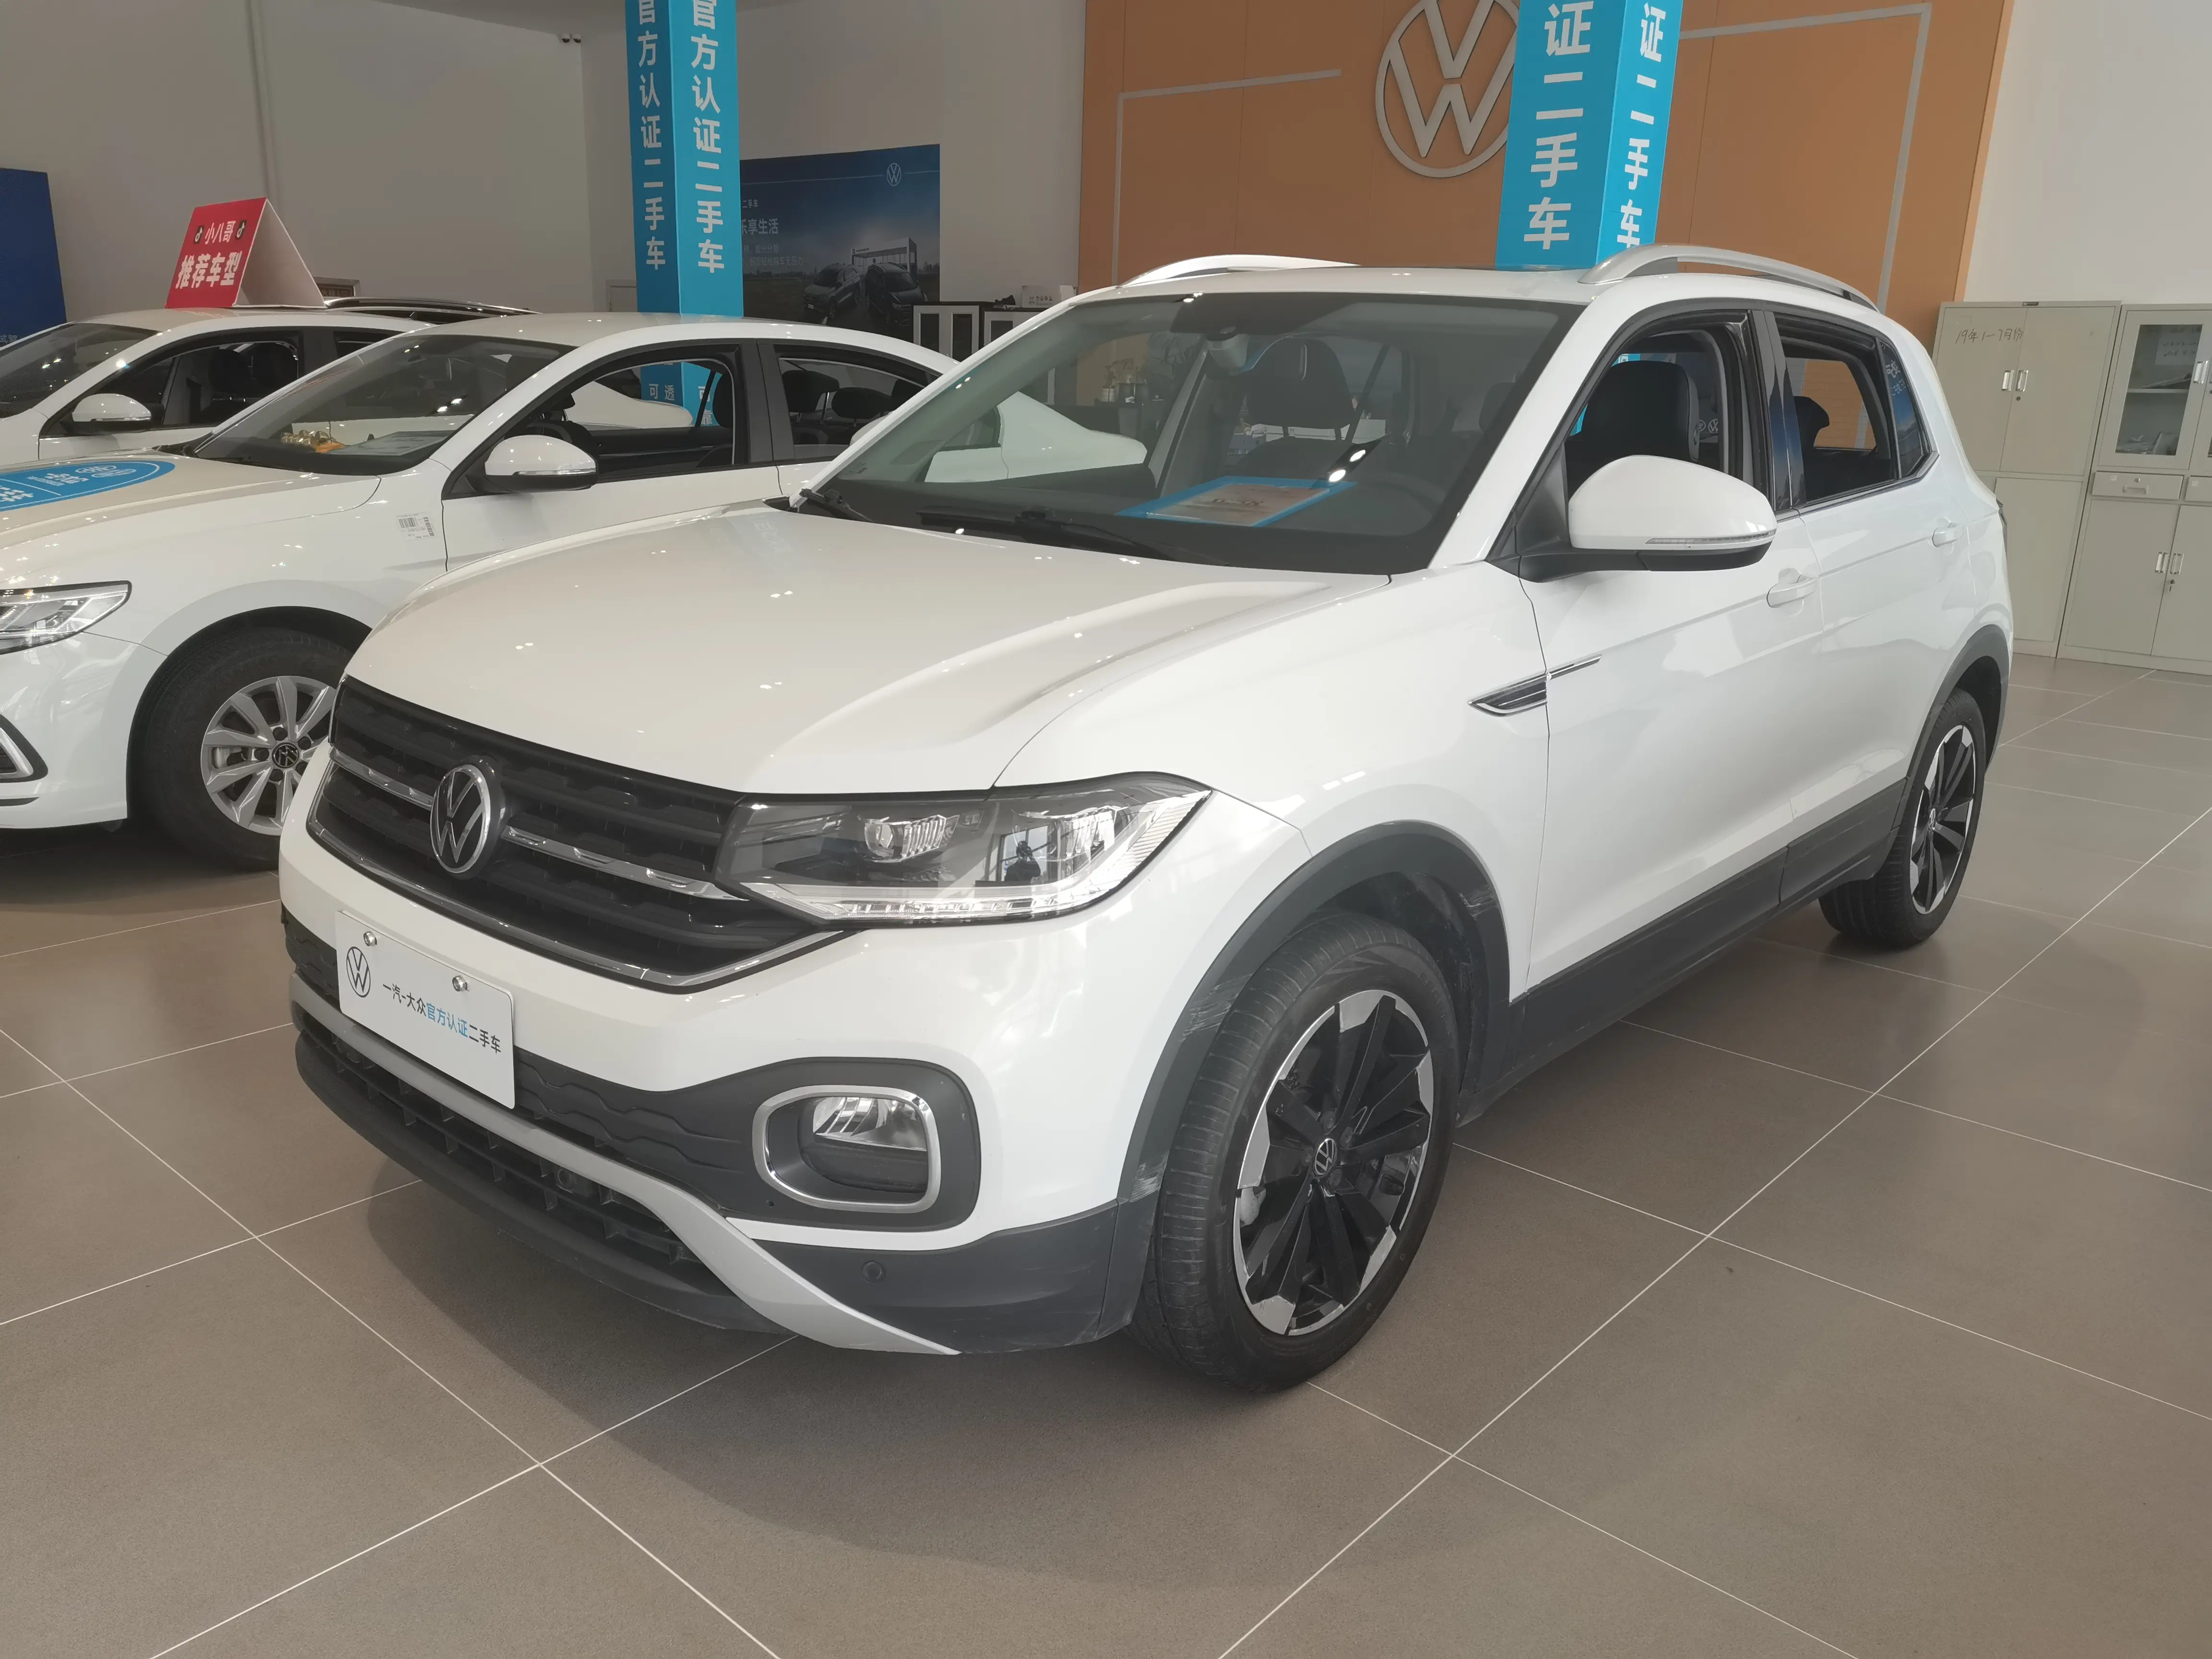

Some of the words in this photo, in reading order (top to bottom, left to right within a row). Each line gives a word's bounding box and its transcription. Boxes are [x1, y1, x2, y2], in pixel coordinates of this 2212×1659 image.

[204, 220, 236, 244] 小八哥
[638, 0, 666, 270] 官方认证二手车
[691, 0, 724, 274] 官方认证二手车
[1524, 1, 1594, 250] 证二手车
[1617, 2, 1666, 249] 证二手车
[175, 251, 243, 289] 推荐车型
